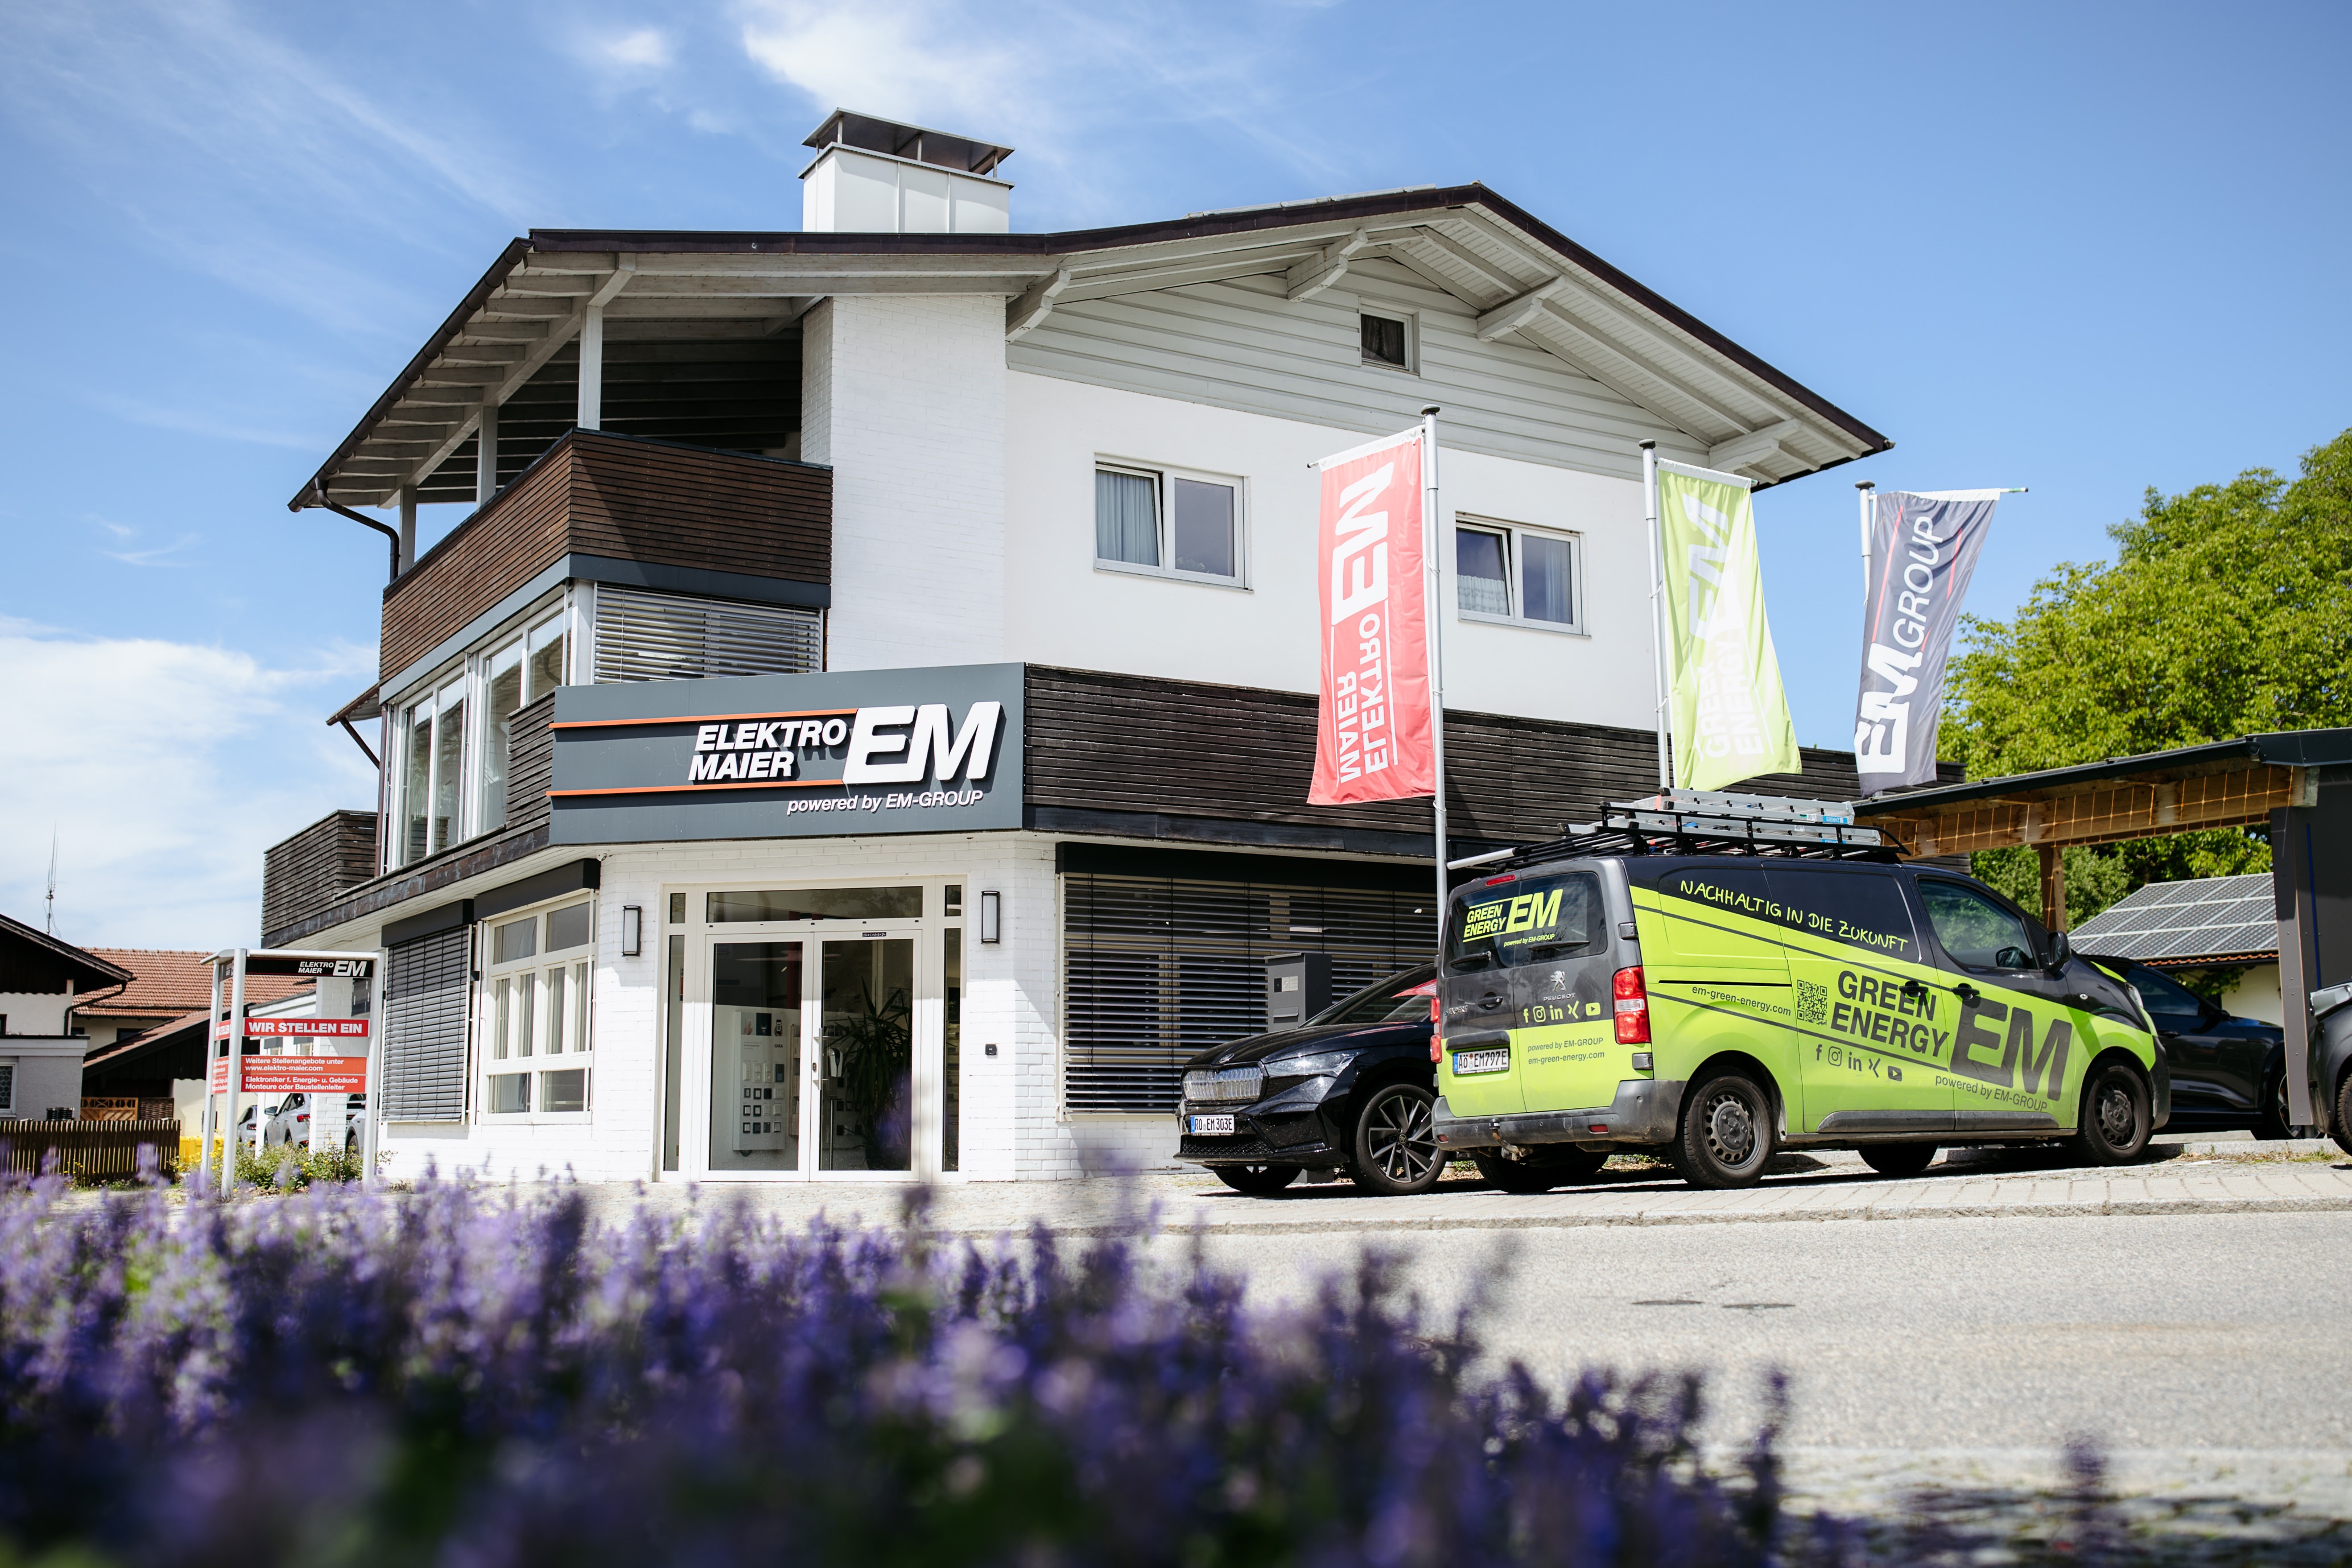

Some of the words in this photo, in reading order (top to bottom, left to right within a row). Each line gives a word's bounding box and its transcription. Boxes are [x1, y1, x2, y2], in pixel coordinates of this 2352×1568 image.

[1854, 642, 1923, 774] EM
[1893, 516, 1943, 648] GROUP
[1715, 641, 1764, 756] ENERGY
[695, 719, 848, 751] ELEKTRO
[842, 701, 1001, 784] EM
[688, 751, 794, 781] MAIER
[786, 795, 859, 815] powered
[861, 795, 882, 812] by
[885, 790, 984, 808] EM-GROUP
[1467, 904, 1503, 923] GREEN
[1505, 889, 1563, 934] EM
[1680, 880, 1781, 918] NACHHALTIG
[1786, 907, 1804, 924] IN
[1809, 913, 1833, 932] DIE
[1838, 920, 1908, 952] ZUKUNFT
[1464, 917, 1507, 938] ENERGY
[1504, 939, 1522, 948] powered
[1528, 934, 1555, 943] EM-GROUP
[333, 960, 367, 977] EM
[1544, 993, 1575, 1001] PEUGEOT
[1692, 986, 1792, 1017] em-green-energy.com
[1838, 970, 1937, 1021] GREEN
[248, 1022, 275, 1033] WIR
[278, 1022, 337, 1033] STELLEN
[340, 1023, 362, 1033] EIN
[1830, 1001, 1950, 1058] ENERGY
[1528, 1042, 1553, 1053] powered
[1564, 1037, 1603, 1048] EM-GROUP
[1528, 1051, 1604, 1065] em-green-energy.com
[1950, 996, 2073, 1101] EM
[1458, 1054, 1468, 1069] AÖ
[1936, 1075, 1978, 1094] powered
[1980, 1084, 1992, 1099] by
[1994, 1088, 2048, 1112] EM-GROUP
[1195, 1118, 1203, 1130] RO
